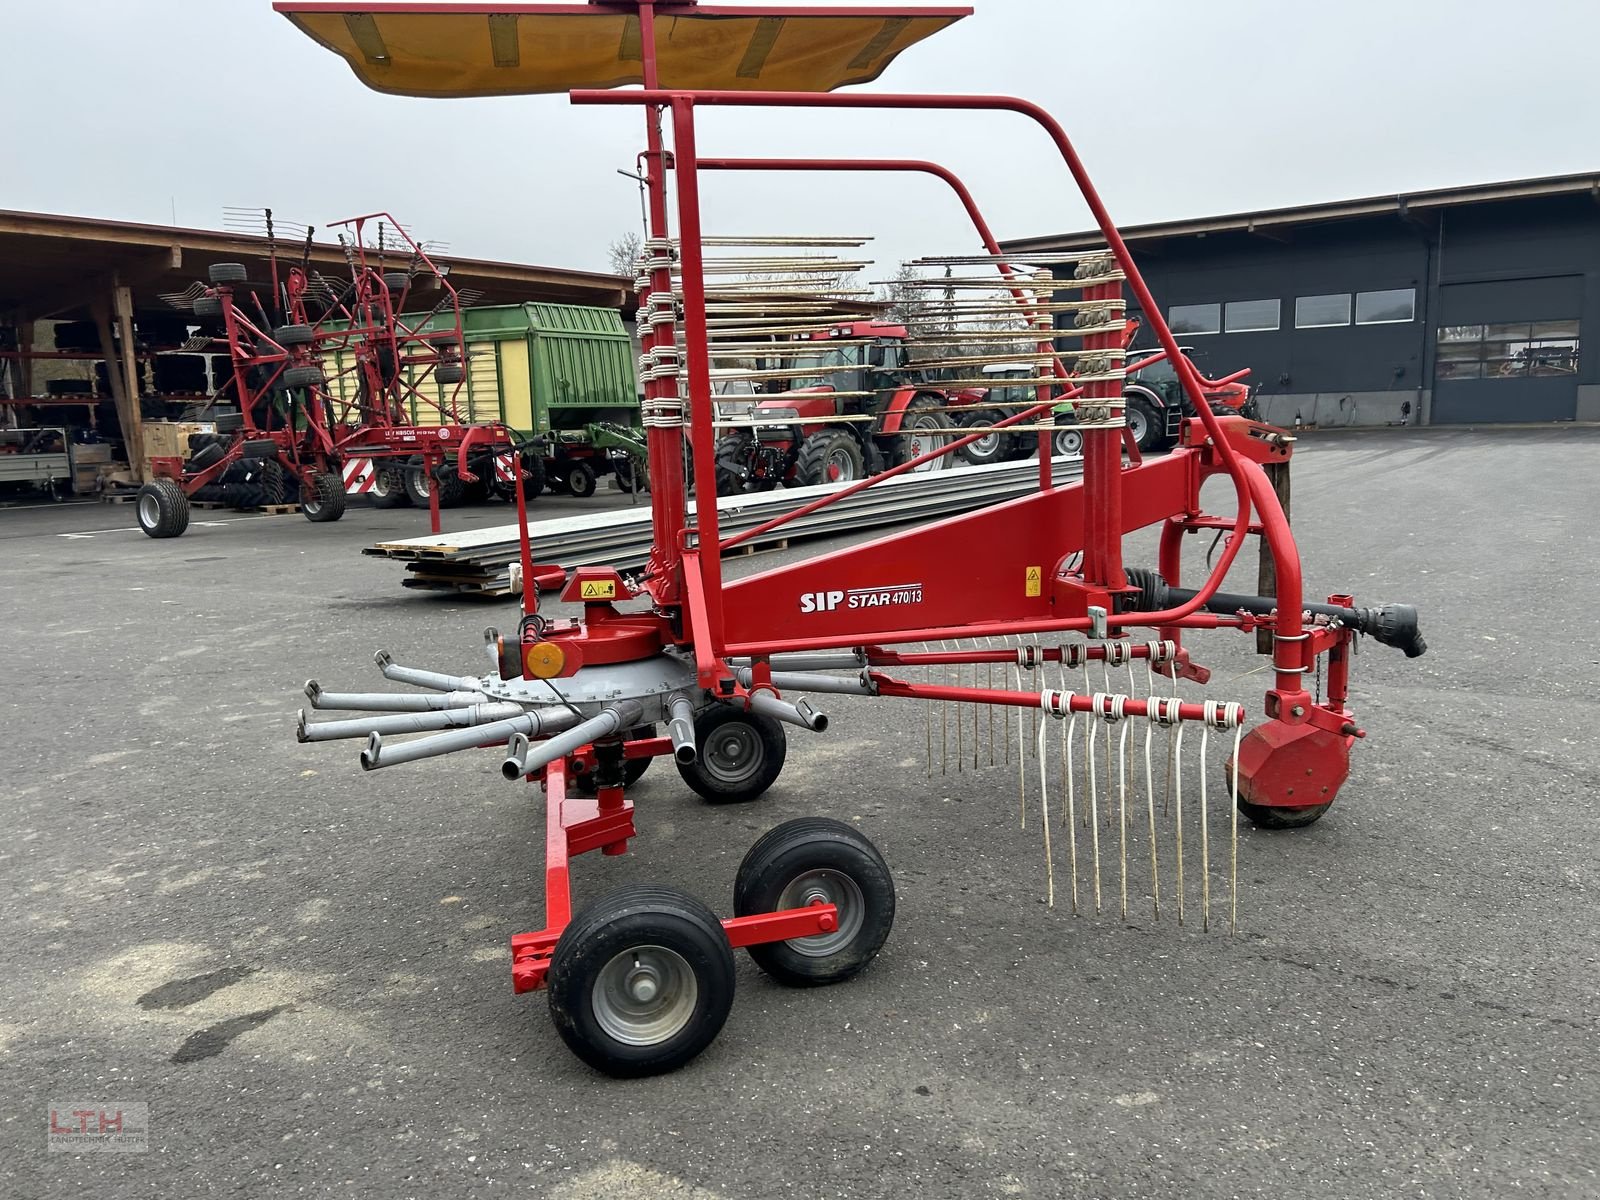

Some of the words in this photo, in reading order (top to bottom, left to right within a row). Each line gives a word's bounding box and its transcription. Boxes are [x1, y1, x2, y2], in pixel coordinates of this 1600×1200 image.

[800, 591, 844, 613] SIP
[848, 593, 891, 609] STAR
[892, 590, 922, 604] 470/13
